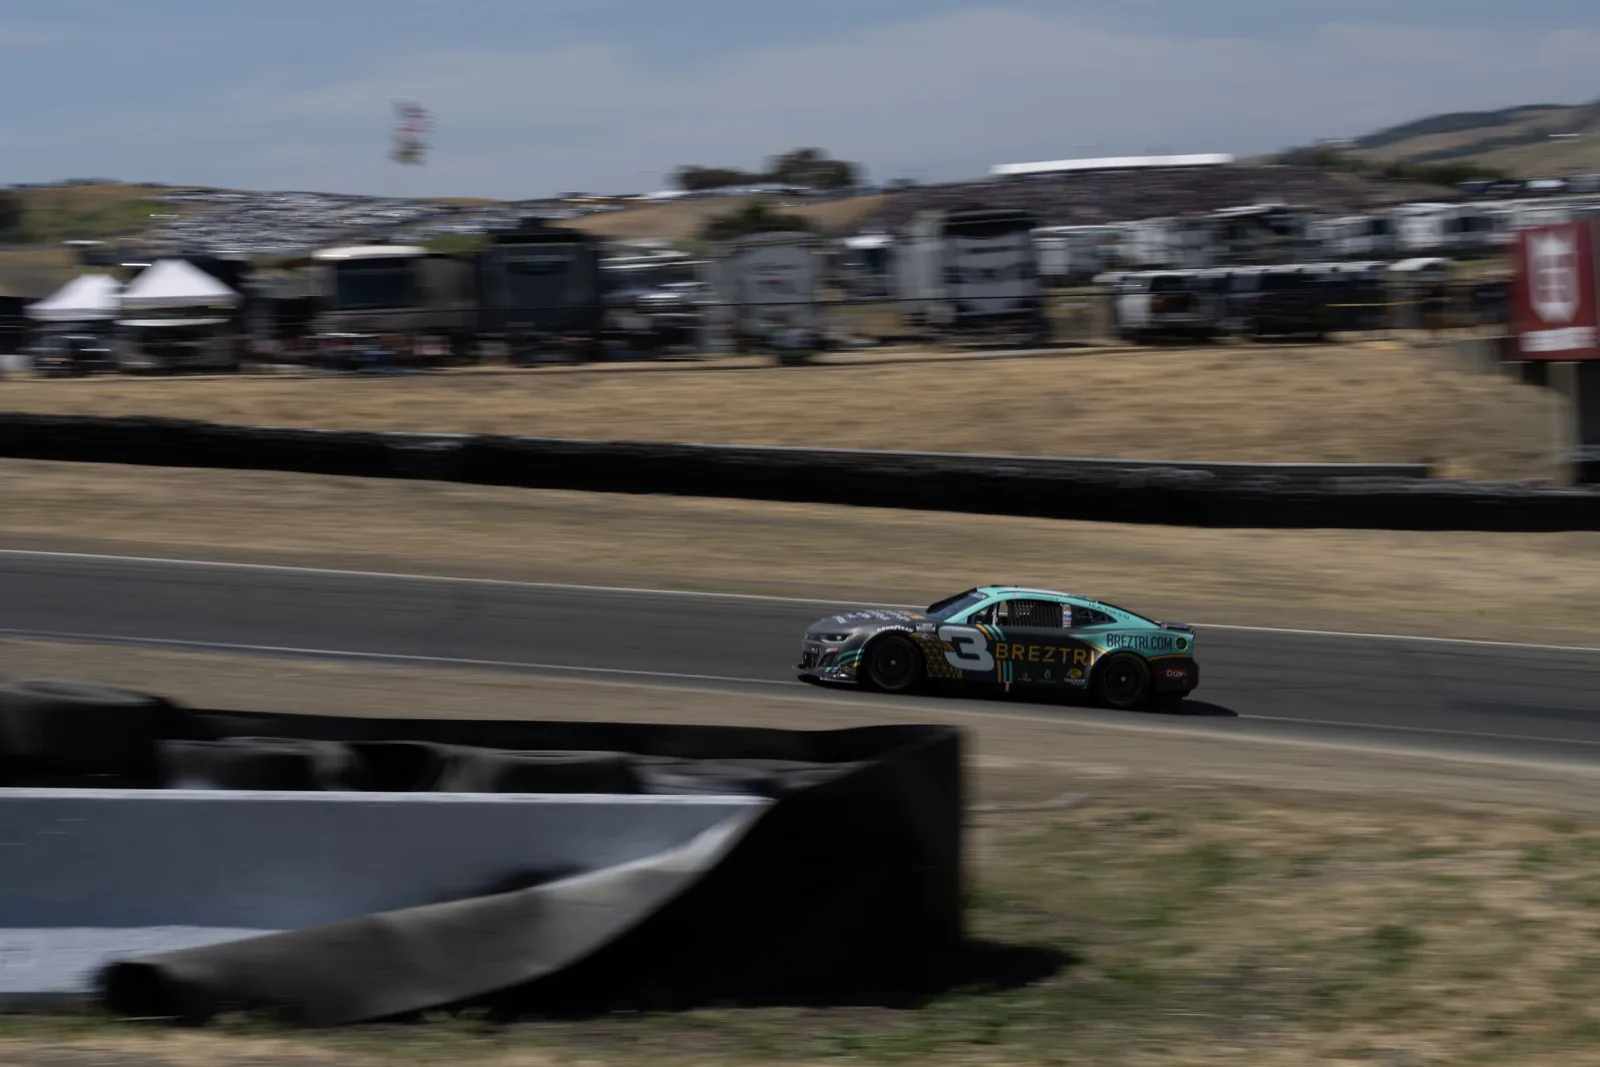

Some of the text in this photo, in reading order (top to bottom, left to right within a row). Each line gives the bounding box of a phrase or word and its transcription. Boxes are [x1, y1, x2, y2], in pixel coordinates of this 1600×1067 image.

[937, 626, 995, 671] 3
[995, 642, 1095, 667] BREZTRI
[1106, 633, 1173, 652] BREZTRI.COM
